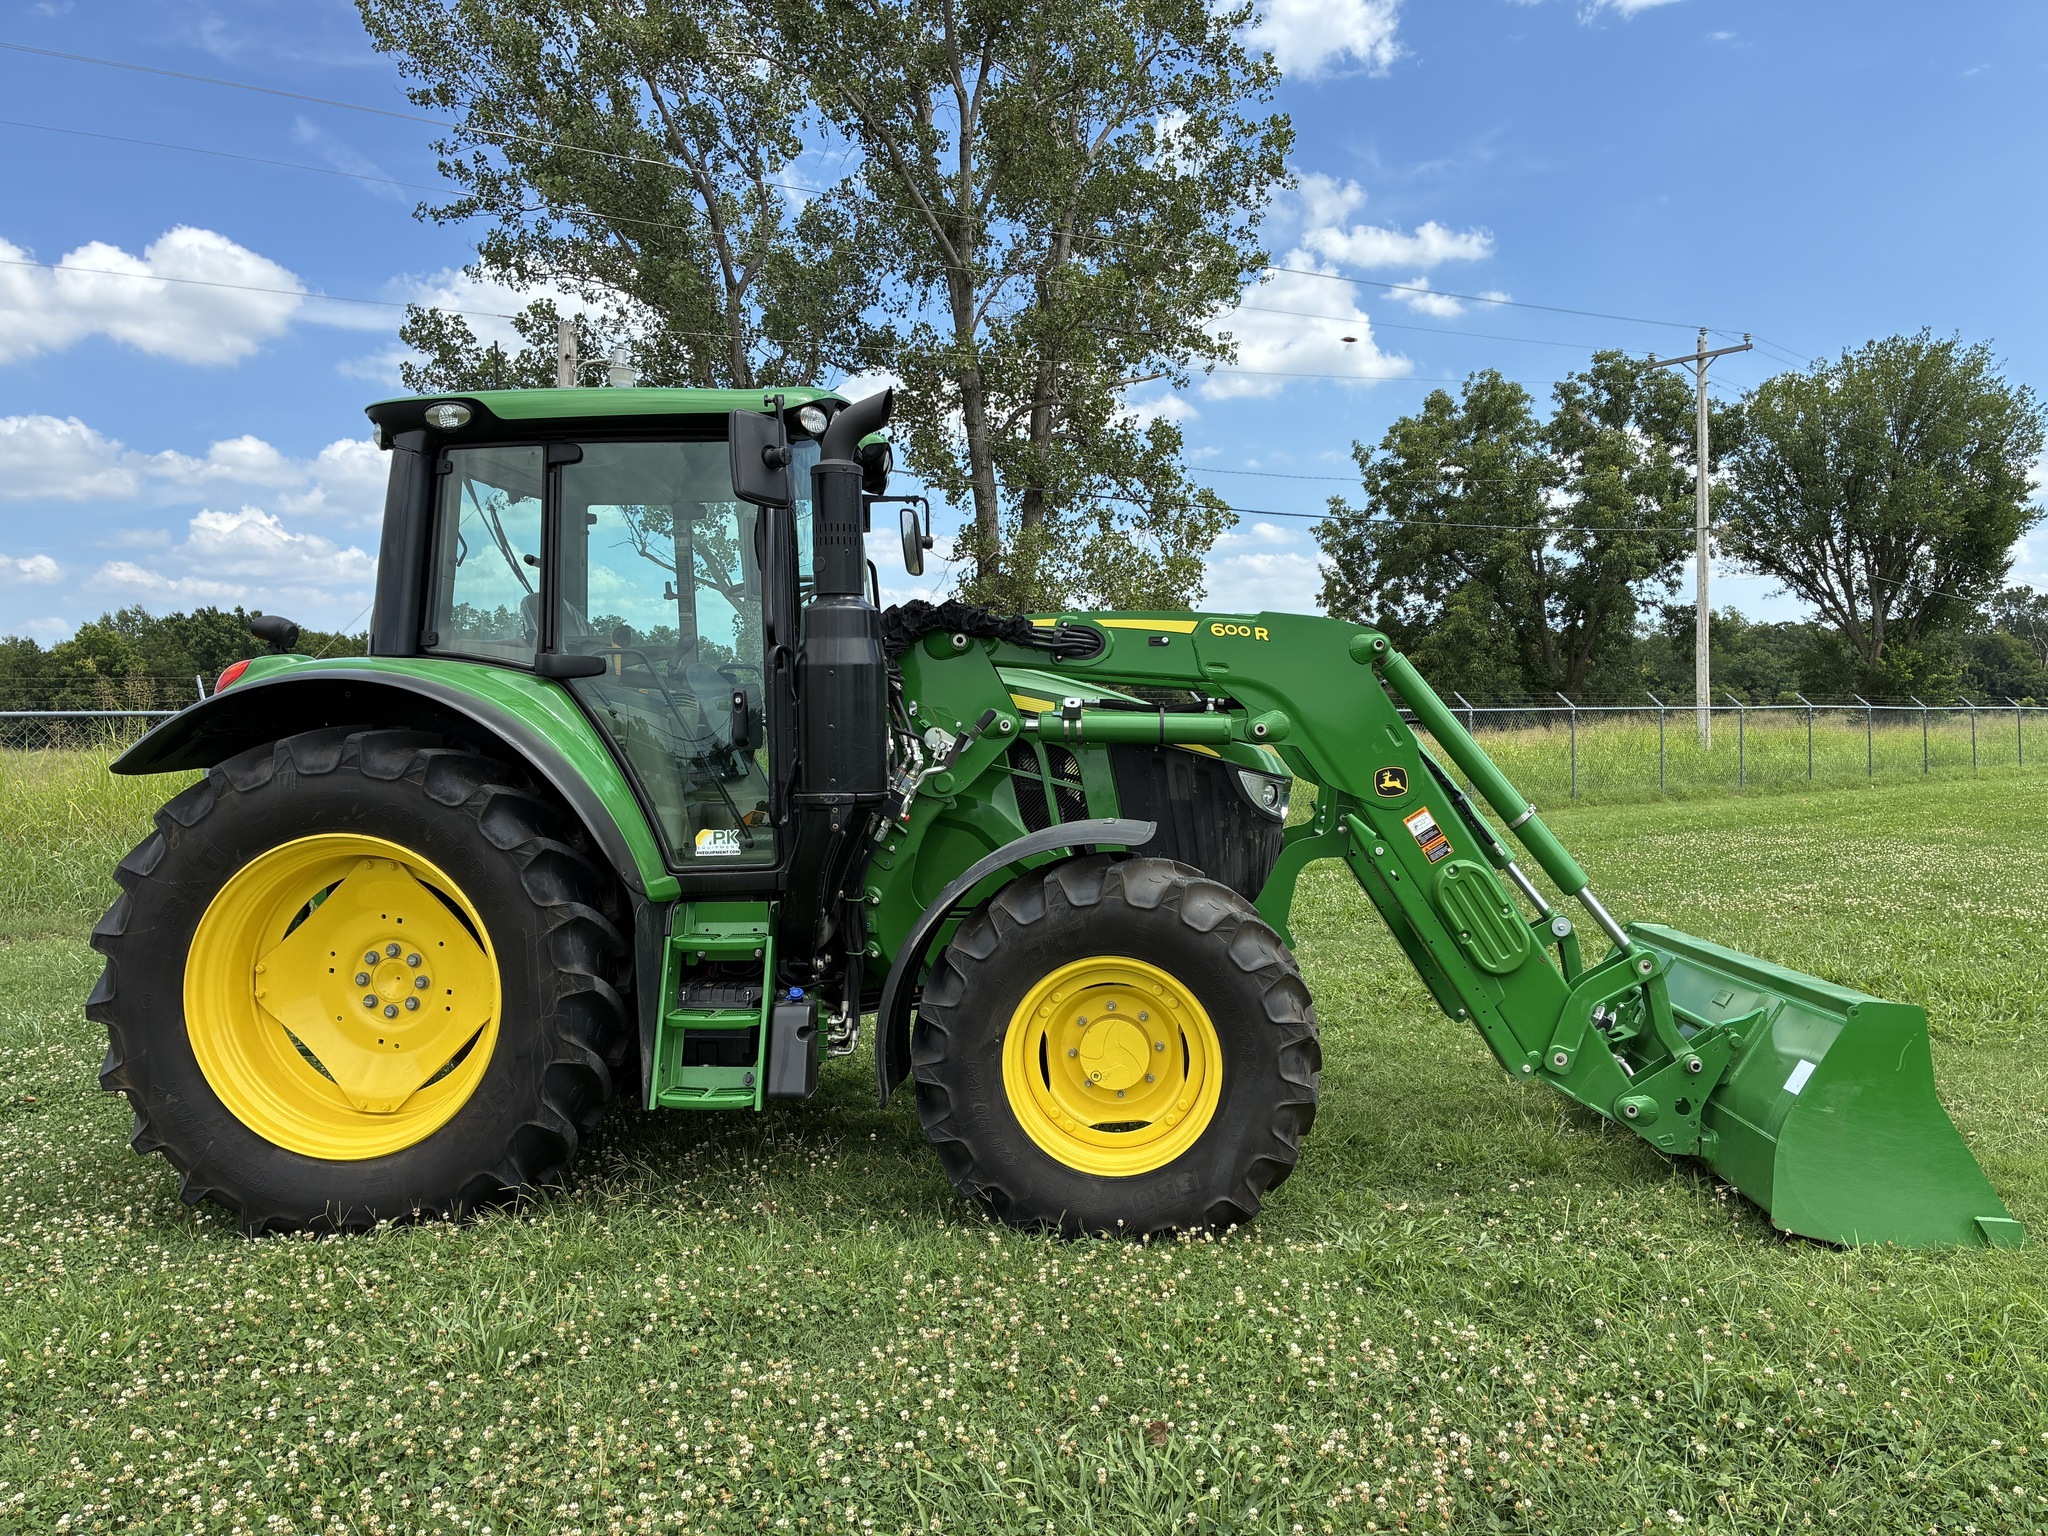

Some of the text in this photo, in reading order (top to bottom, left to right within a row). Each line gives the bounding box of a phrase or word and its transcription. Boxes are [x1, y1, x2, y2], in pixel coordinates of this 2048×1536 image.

[1210, 622, 1270, 641] 600 R
[1024, 918, 1089, 968] BKT
